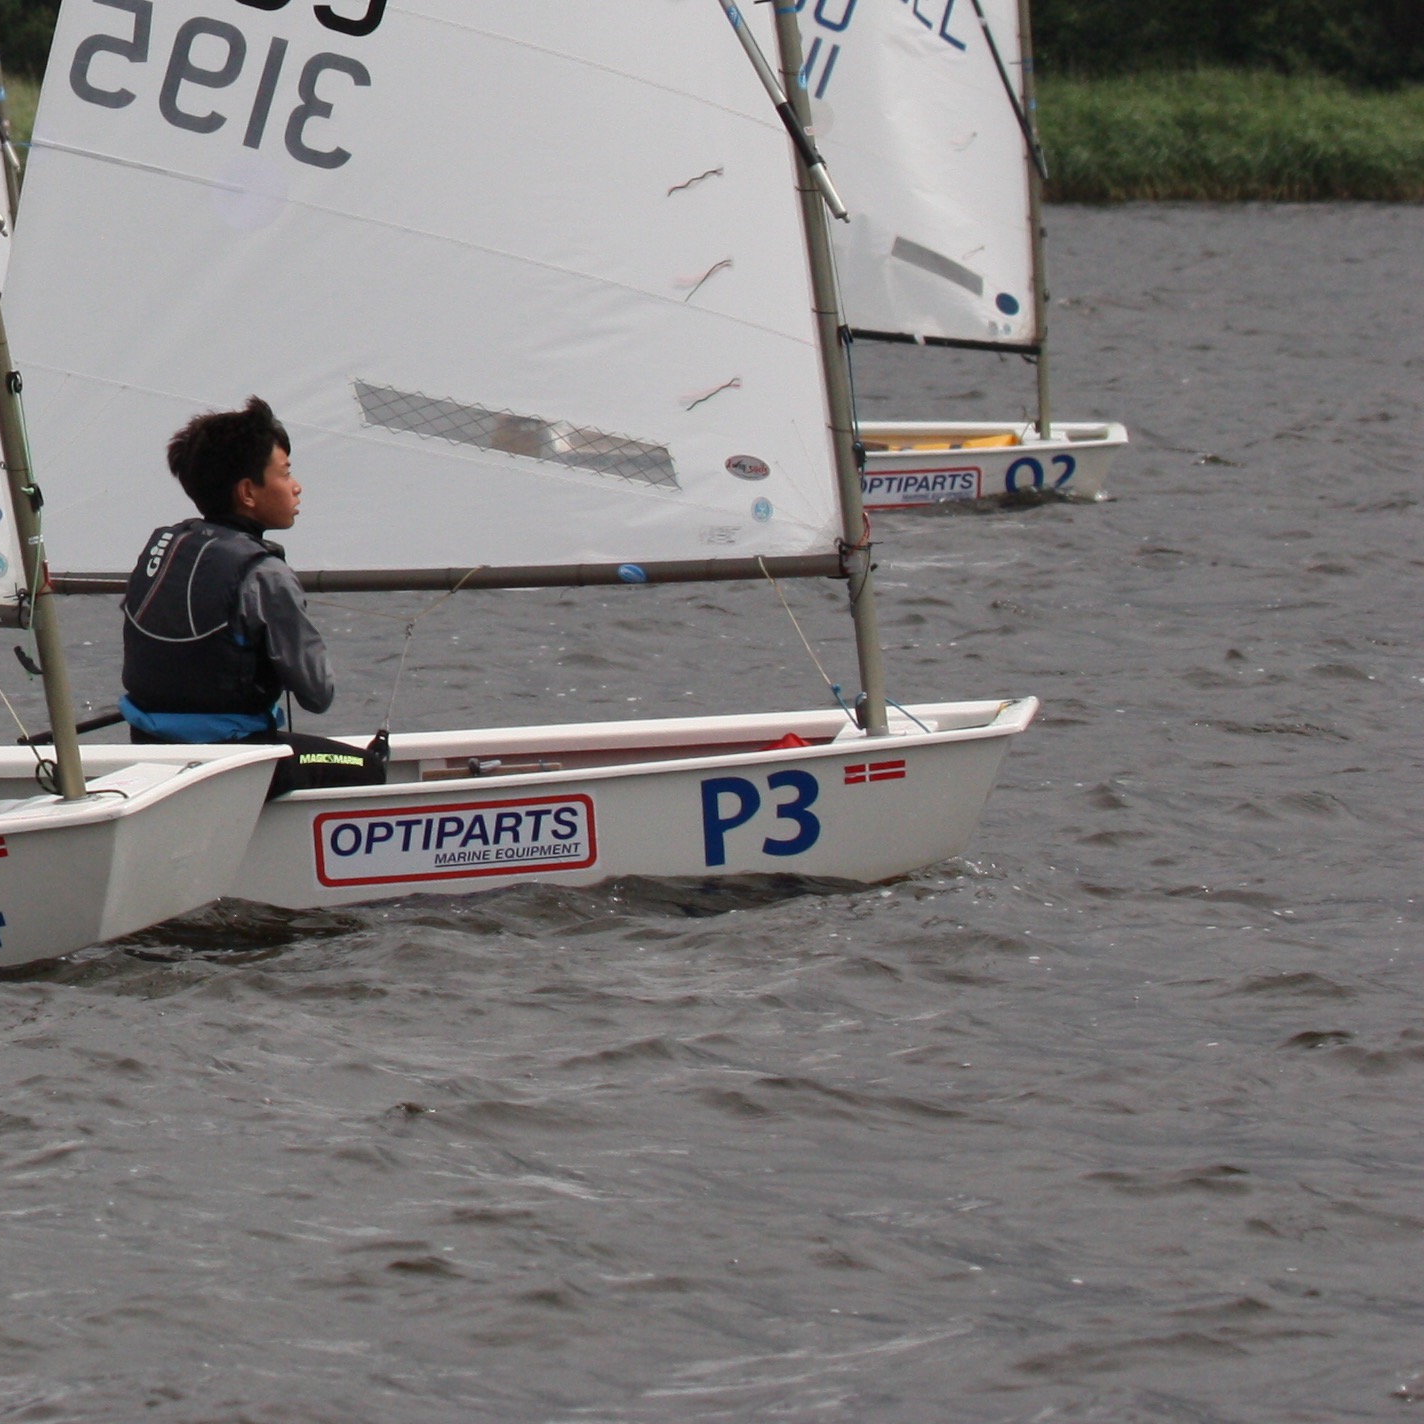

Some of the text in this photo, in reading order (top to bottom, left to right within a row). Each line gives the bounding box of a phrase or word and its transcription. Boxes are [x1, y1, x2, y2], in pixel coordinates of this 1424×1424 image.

[330, 805, 579, 858] OPTIPARTS
[701, 769, 821, 867] P3
[434, 842, 582, 864] MARINE EQUIPMENT
